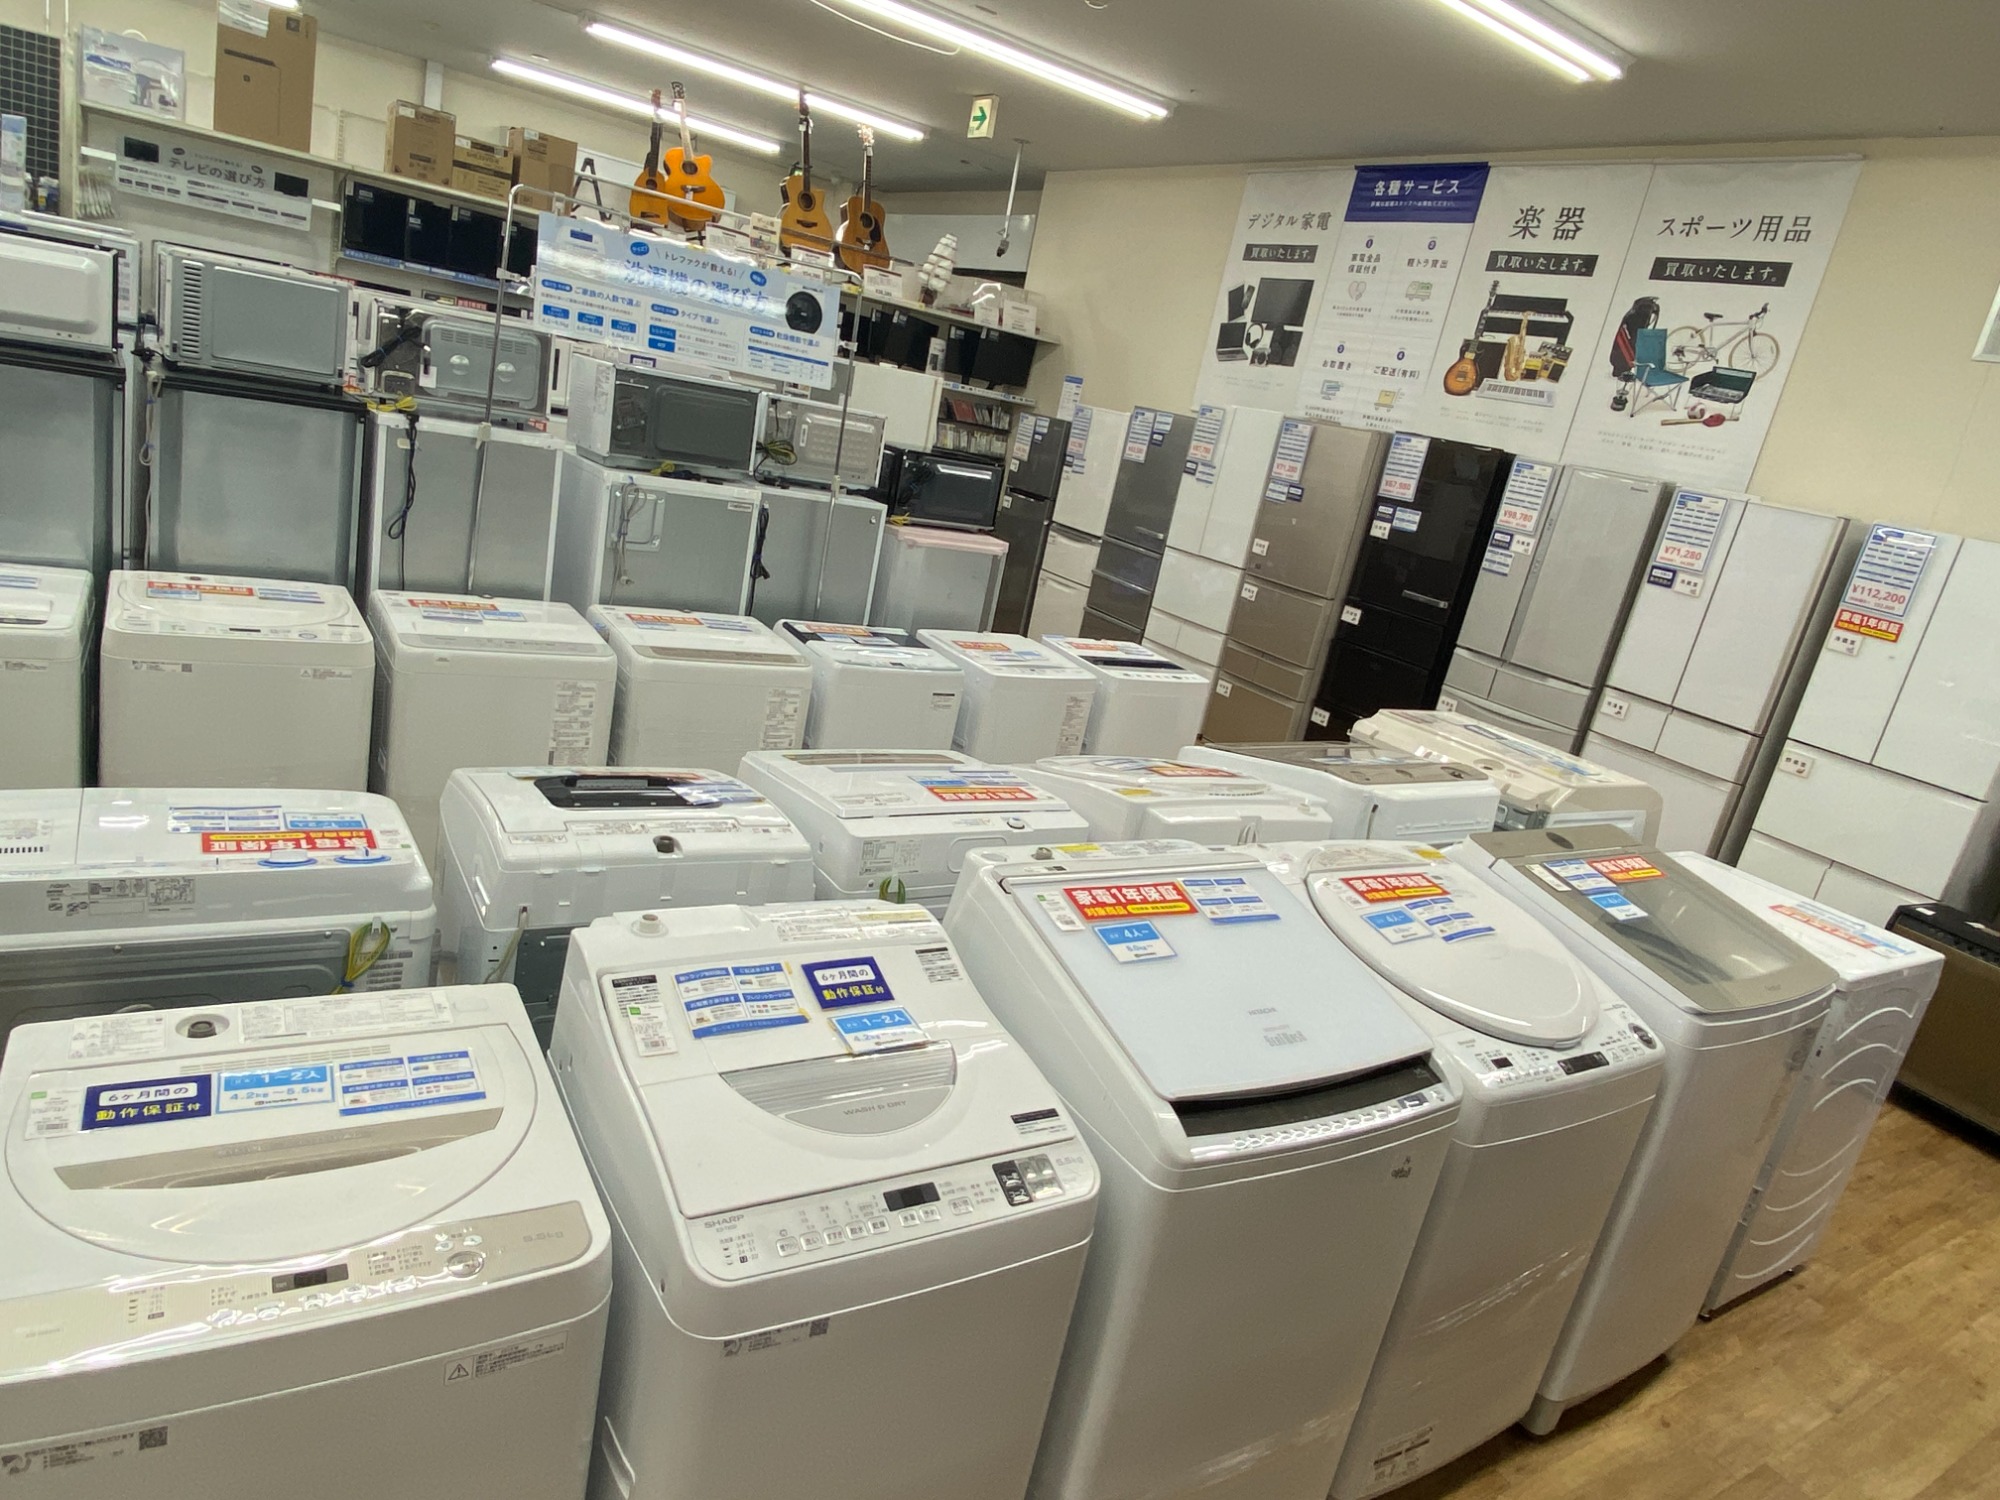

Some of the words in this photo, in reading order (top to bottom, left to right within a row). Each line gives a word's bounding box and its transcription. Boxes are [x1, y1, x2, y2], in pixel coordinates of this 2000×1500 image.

[168, 157, 266, 189] テレビの選び方
[1374, 179, 1459, 197] 各種サービス
[1248, 211, 1332, 231] デジタル家電
[1508, 205, 1586, 241] 楽器
[1657, 214, 1812, 243] スポーツ用品
[1250, 247, 1312, 261] 買取いたします。
[1351, 253, 1381, 263] 家電全品
[1348, 264, 1378, 275] 保証付き
[1407, 258, 1449, 269] 軽トラ貸出
[1494, 254, 1590, 273] 買取いたします。
[1663, 261, 1780, 283] 買取いたします。
[1322, 359, 1352, 371] お取置き
[1503, 509, 1534, 523] ¥98,780
[1664, 546, 1702, 562] ¥71,280
[1851, 583, 1906, 605] ¥112,200
[1840, 611, 1900, 634] 家電1年保証
[1348, 874, 1434, 891] 家電1年保証
[1071, 885, 1183, 906] 家電1年保証
[821, 969, 869, 982] 6ヶ月間の
[821, 984, 885, 1000] 動作保証付
[108, 1086, 189, 1102] 6ヶ月間の
[95, 1102, 202, 1122] 動作保証付
[843, 1105, 876, 1115] WASH
[704, 1214, 745, 1229] SHARP
